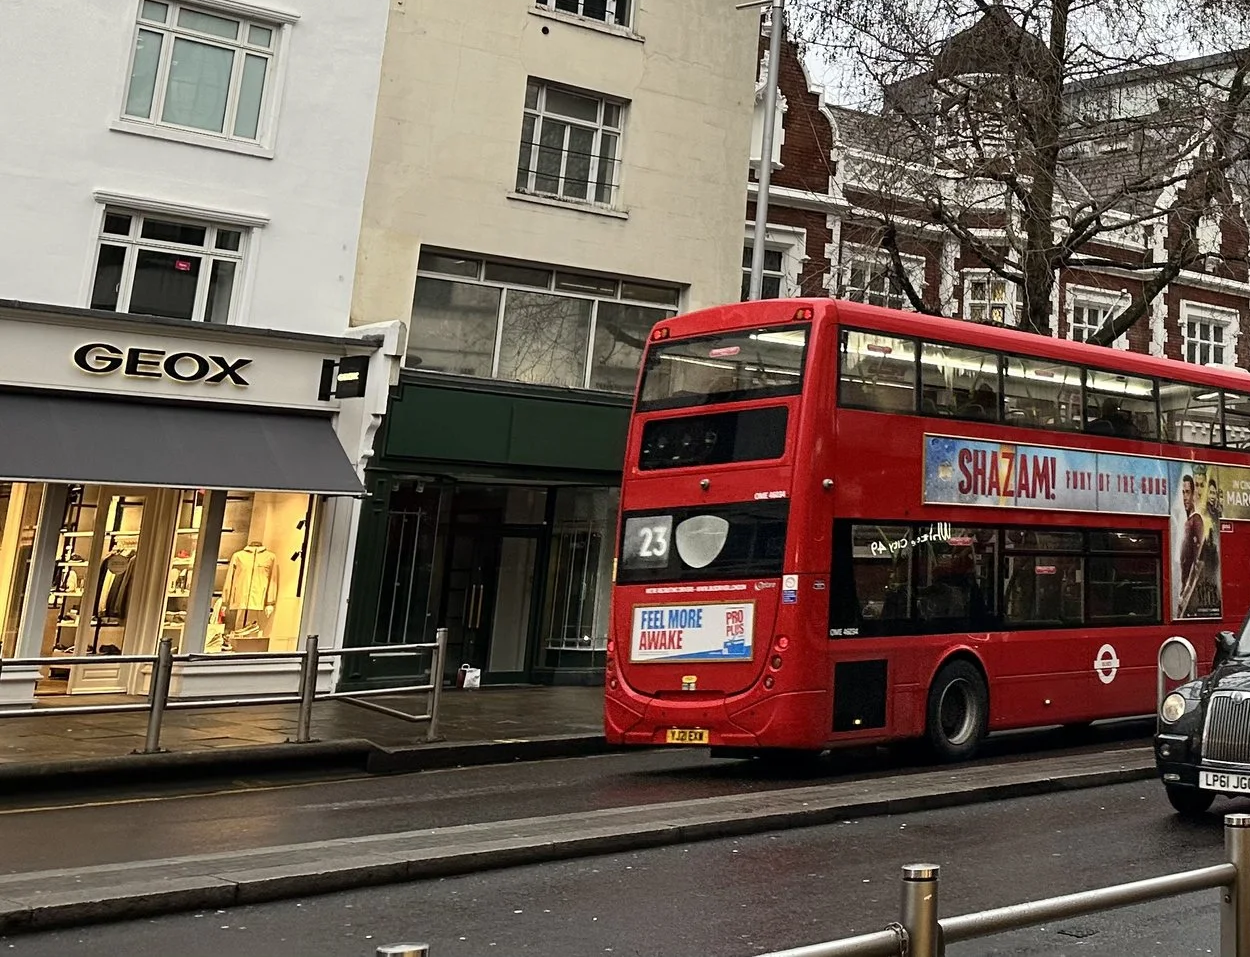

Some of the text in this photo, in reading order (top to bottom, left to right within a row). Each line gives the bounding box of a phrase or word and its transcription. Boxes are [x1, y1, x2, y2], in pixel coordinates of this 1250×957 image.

[74, 343, 253, 386] GEOX
[958, 448, 1057, 501] SHAZAM!
[1065, 470, 1166, 495] FURY OF THE GODS
[1232, 480, 1240, 489] IN
[639, 526, 668, 557] 23
[641, 609, 703, 630] FEEL MORE
[725, 610, 744, 624] PRO
[639, 630, 684, 651] AWAKE
[726, 624, 744, 637] PLUS
[1206, 774, 1229, 788] LP61
